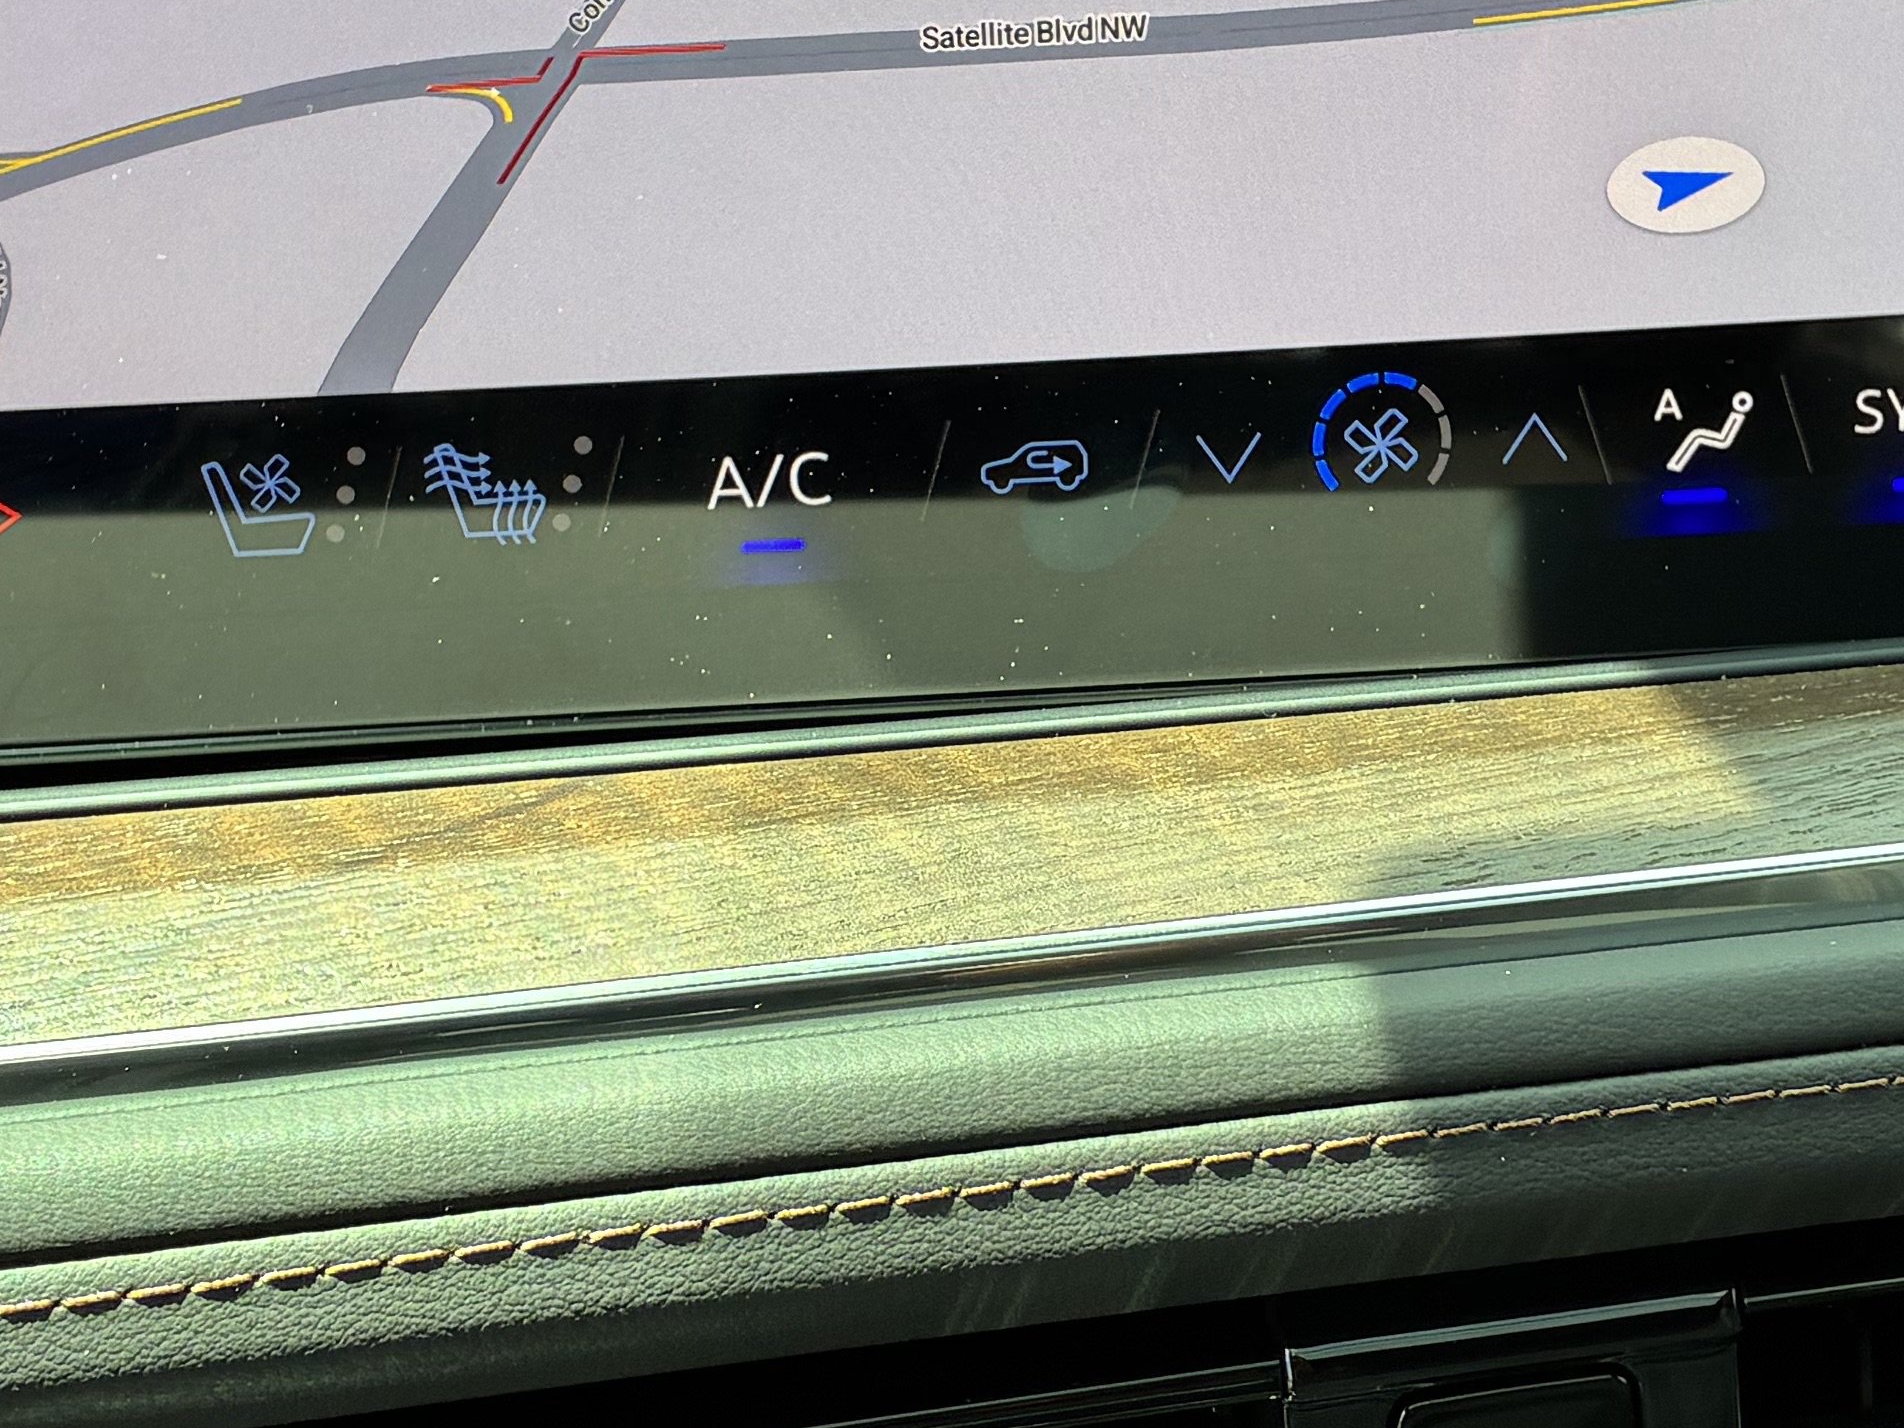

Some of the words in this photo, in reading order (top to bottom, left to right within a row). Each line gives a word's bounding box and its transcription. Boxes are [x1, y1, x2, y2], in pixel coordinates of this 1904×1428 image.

[922, 20, 1032, 50] Satellite
[1036, 17, 1093, 45] Blvd
[1098, 15, 1148, 41] NW
[1654, 391, 1683, 423] A
[706, 452, 832, 511] A/C
